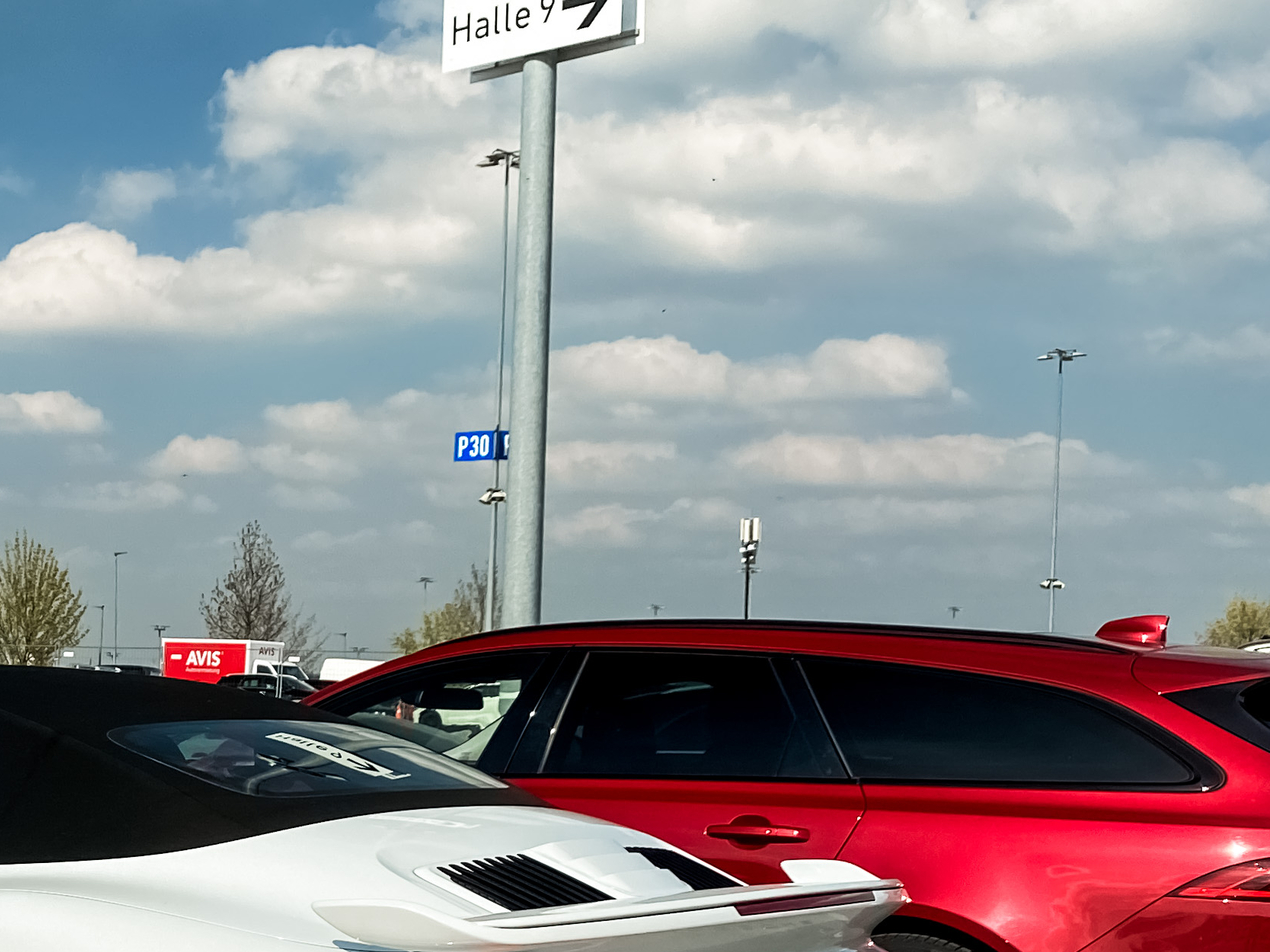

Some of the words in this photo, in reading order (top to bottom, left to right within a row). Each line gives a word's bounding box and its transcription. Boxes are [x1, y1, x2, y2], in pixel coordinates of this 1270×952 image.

[452, 2, 531, 46] Halle
[541, 0, 556, 23] 9
[457, 434, 490, 459] P30
[185, 650, 221, 667] AVIS
[259, 646, 275, 656] AVIS
